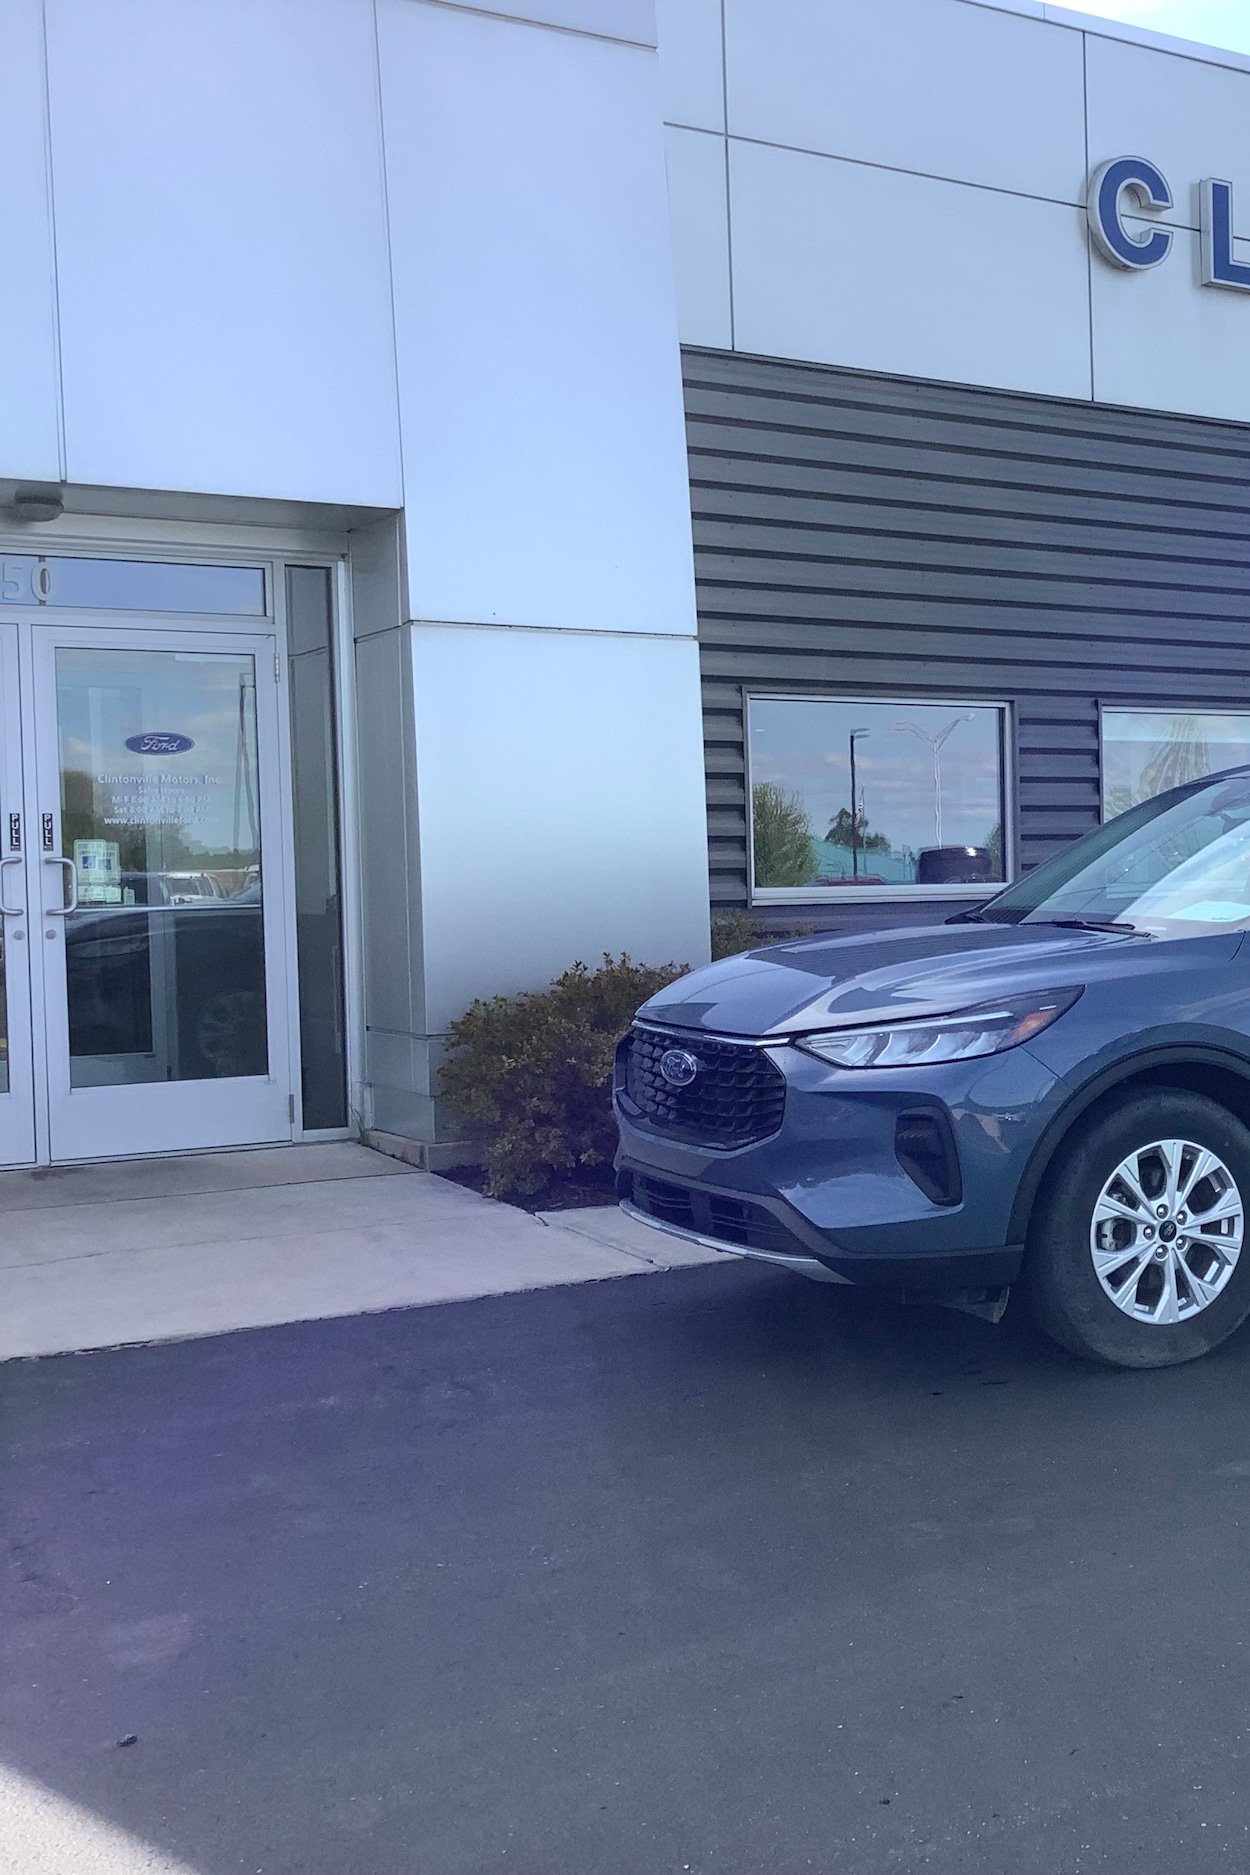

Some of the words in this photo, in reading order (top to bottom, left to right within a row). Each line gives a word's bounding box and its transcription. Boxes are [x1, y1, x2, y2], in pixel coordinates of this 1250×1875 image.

[97, 774, 159, 785] Clintonville
[11, 813, 20, 846] PULL
[44, 813, 53, 846] PULL
